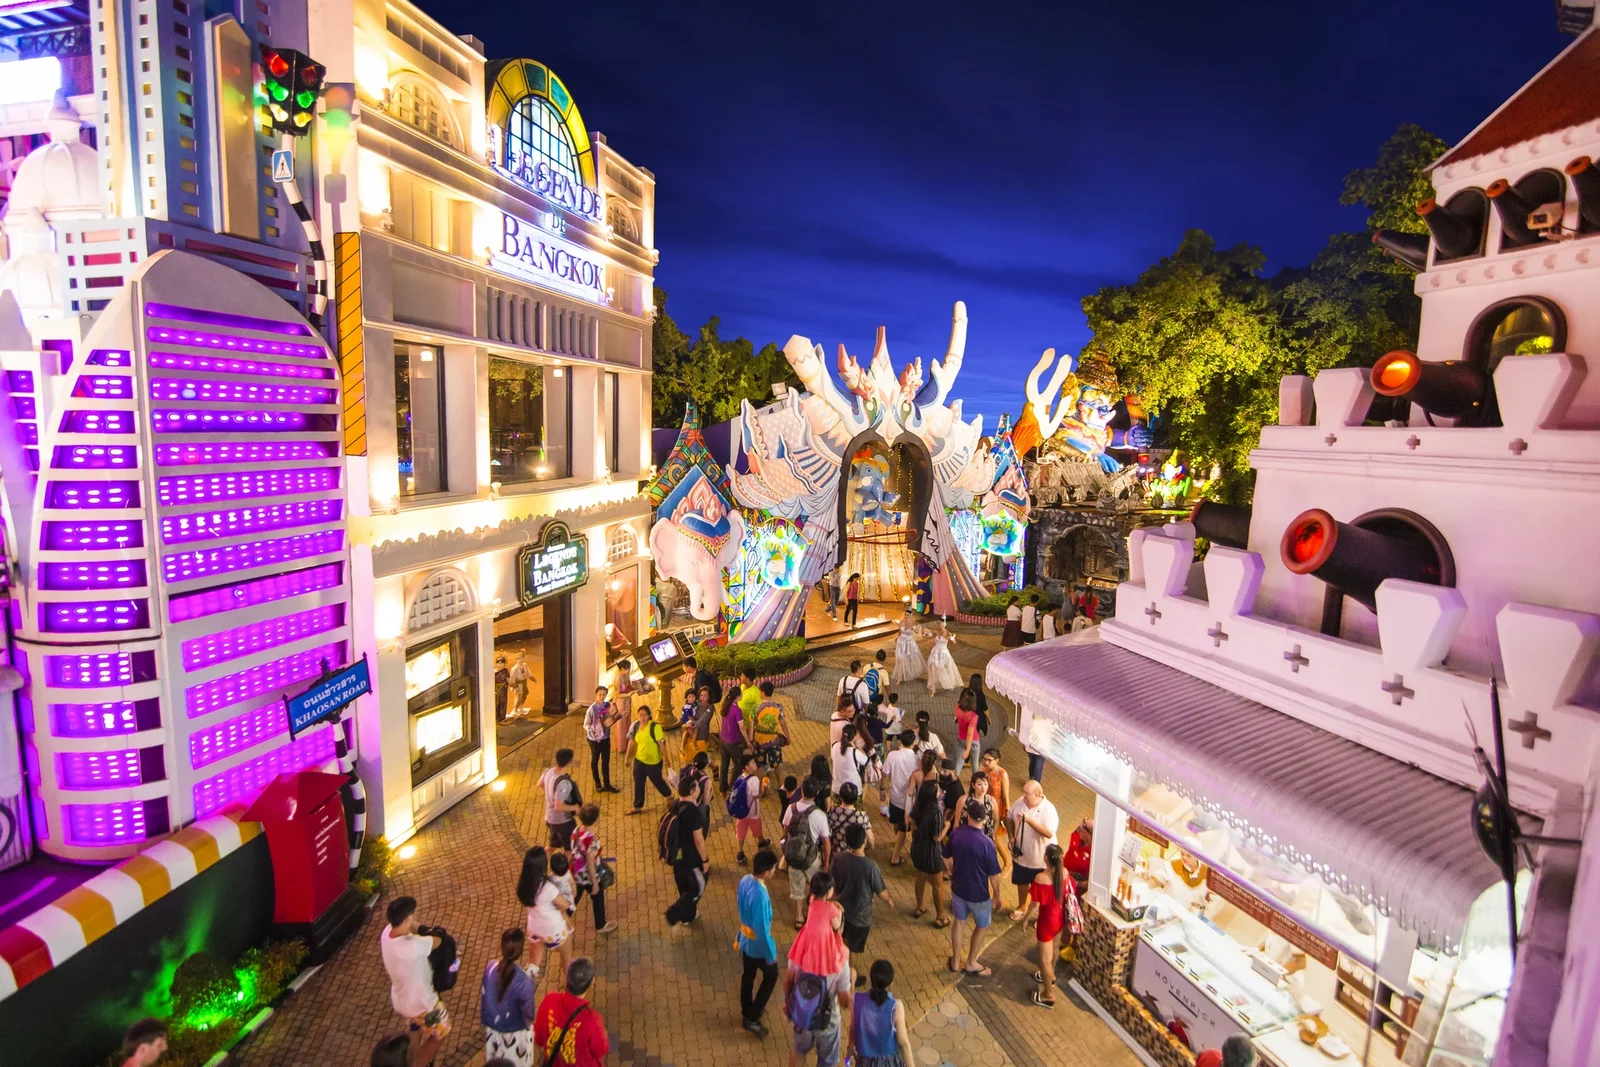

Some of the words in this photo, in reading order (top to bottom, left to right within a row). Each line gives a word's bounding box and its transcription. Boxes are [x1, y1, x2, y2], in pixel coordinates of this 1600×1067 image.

[507, 144, 604, 221] LEGENDE
[501, 211, 604, 293] BANGKOK
[551, 214, 566, 233] DE
[533, 562, 579, 586] BANGKOK
[295, 696, 342, 727] KHAOSAN
[342, 680, 367, 700] ROAD
[1233, 883, 1253, 900] when
[1254, 899, 1272, 913] your
[1273, 911, 1295, 928] order
[1307, 931, 1331, 952] ready
